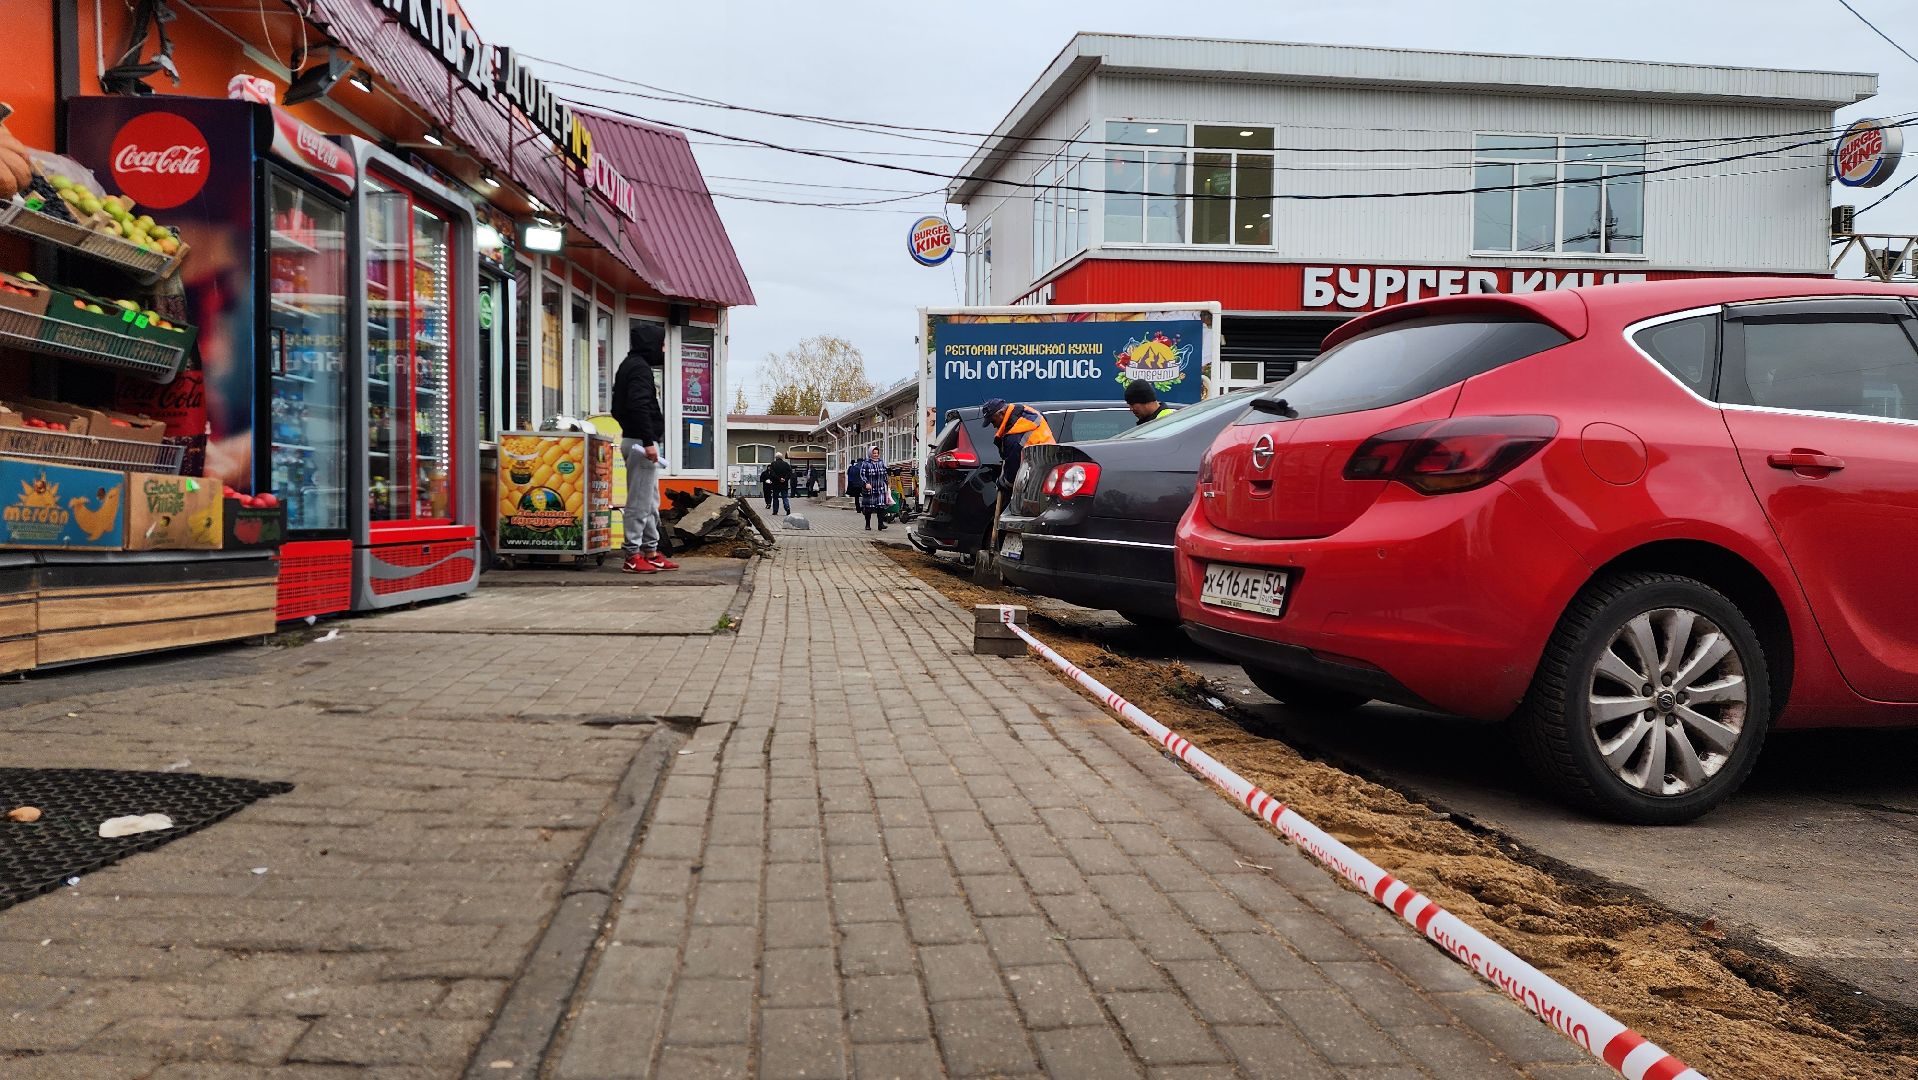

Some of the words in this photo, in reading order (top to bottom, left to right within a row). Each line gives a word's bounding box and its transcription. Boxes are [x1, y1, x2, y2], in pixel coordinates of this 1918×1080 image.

[506, 46, 573, 146] ДОНЕР
[1840, 129, 1881, 161] BURGER
[1840, 137, 1883, 177] KING
[115, 144, 206, 174] Coca-Cola
[595, 153, 636, 222] СКУПКА
[913, 224, 949, 243] BURGER
[916, 233, 952, 255] KING
[1303, 267, 1500, 308] БУРГЕР
[945, 344, 997, 356] РЕСТОРАН
[1000, 343, 1066, 356] ГРУЗИНСКОЙ
[1068, 343, 1103, 355] КУХНИ
[945, 361, 981, 380] МЫ
[987, 359, 1101, 380] ОТКРЫЛИСЬ
[777, 433, 829, 443] ДЕДОВ
[144, 479, 180, 495] Global
[146, 492, 184, 516] Village
